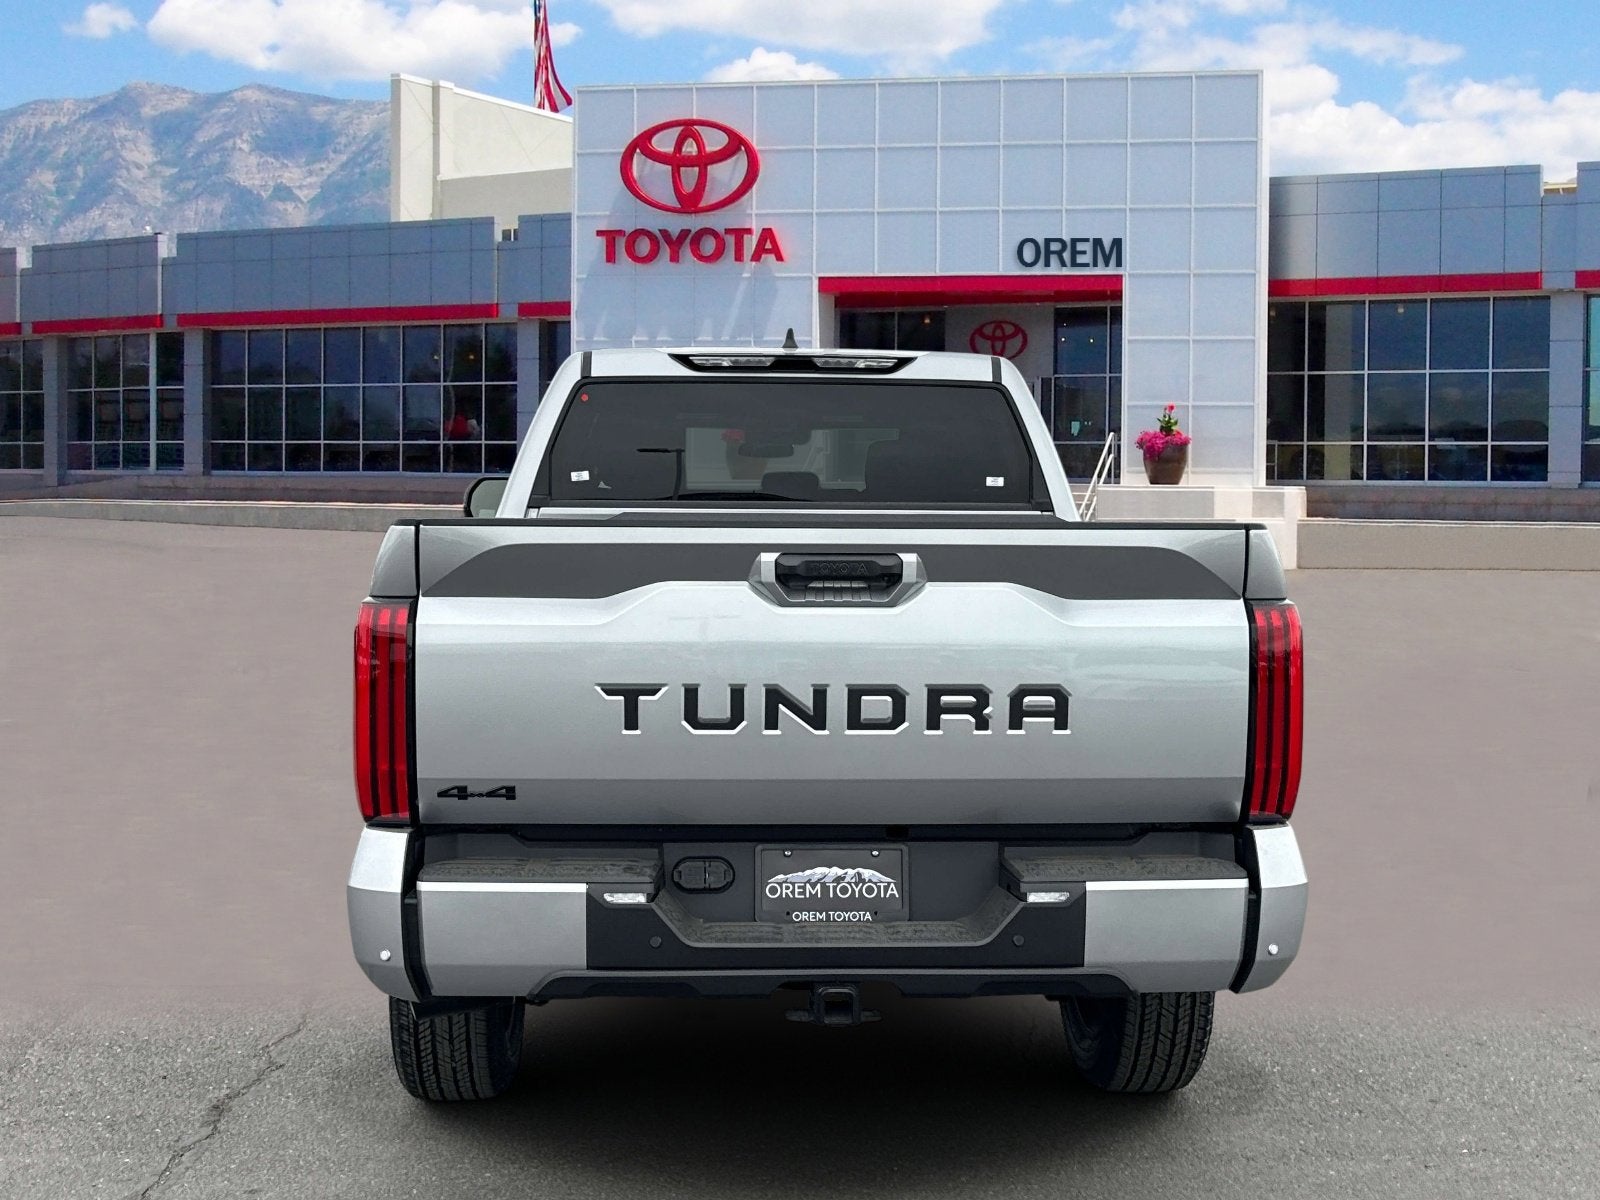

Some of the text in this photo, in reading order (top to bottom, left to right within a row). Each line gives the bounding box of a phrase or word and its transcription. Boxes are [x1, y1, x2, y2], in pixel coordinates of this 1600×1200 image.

[596, 227, 785, 264] TOYOTA
[1016, 237, 1123, 268] OREM
[594, 683, 1073, 735] TUNDRA
[765, 882, 899, 899] OREM TOYOTA
[792, 911, 872, 922] OREM TOYOTA
